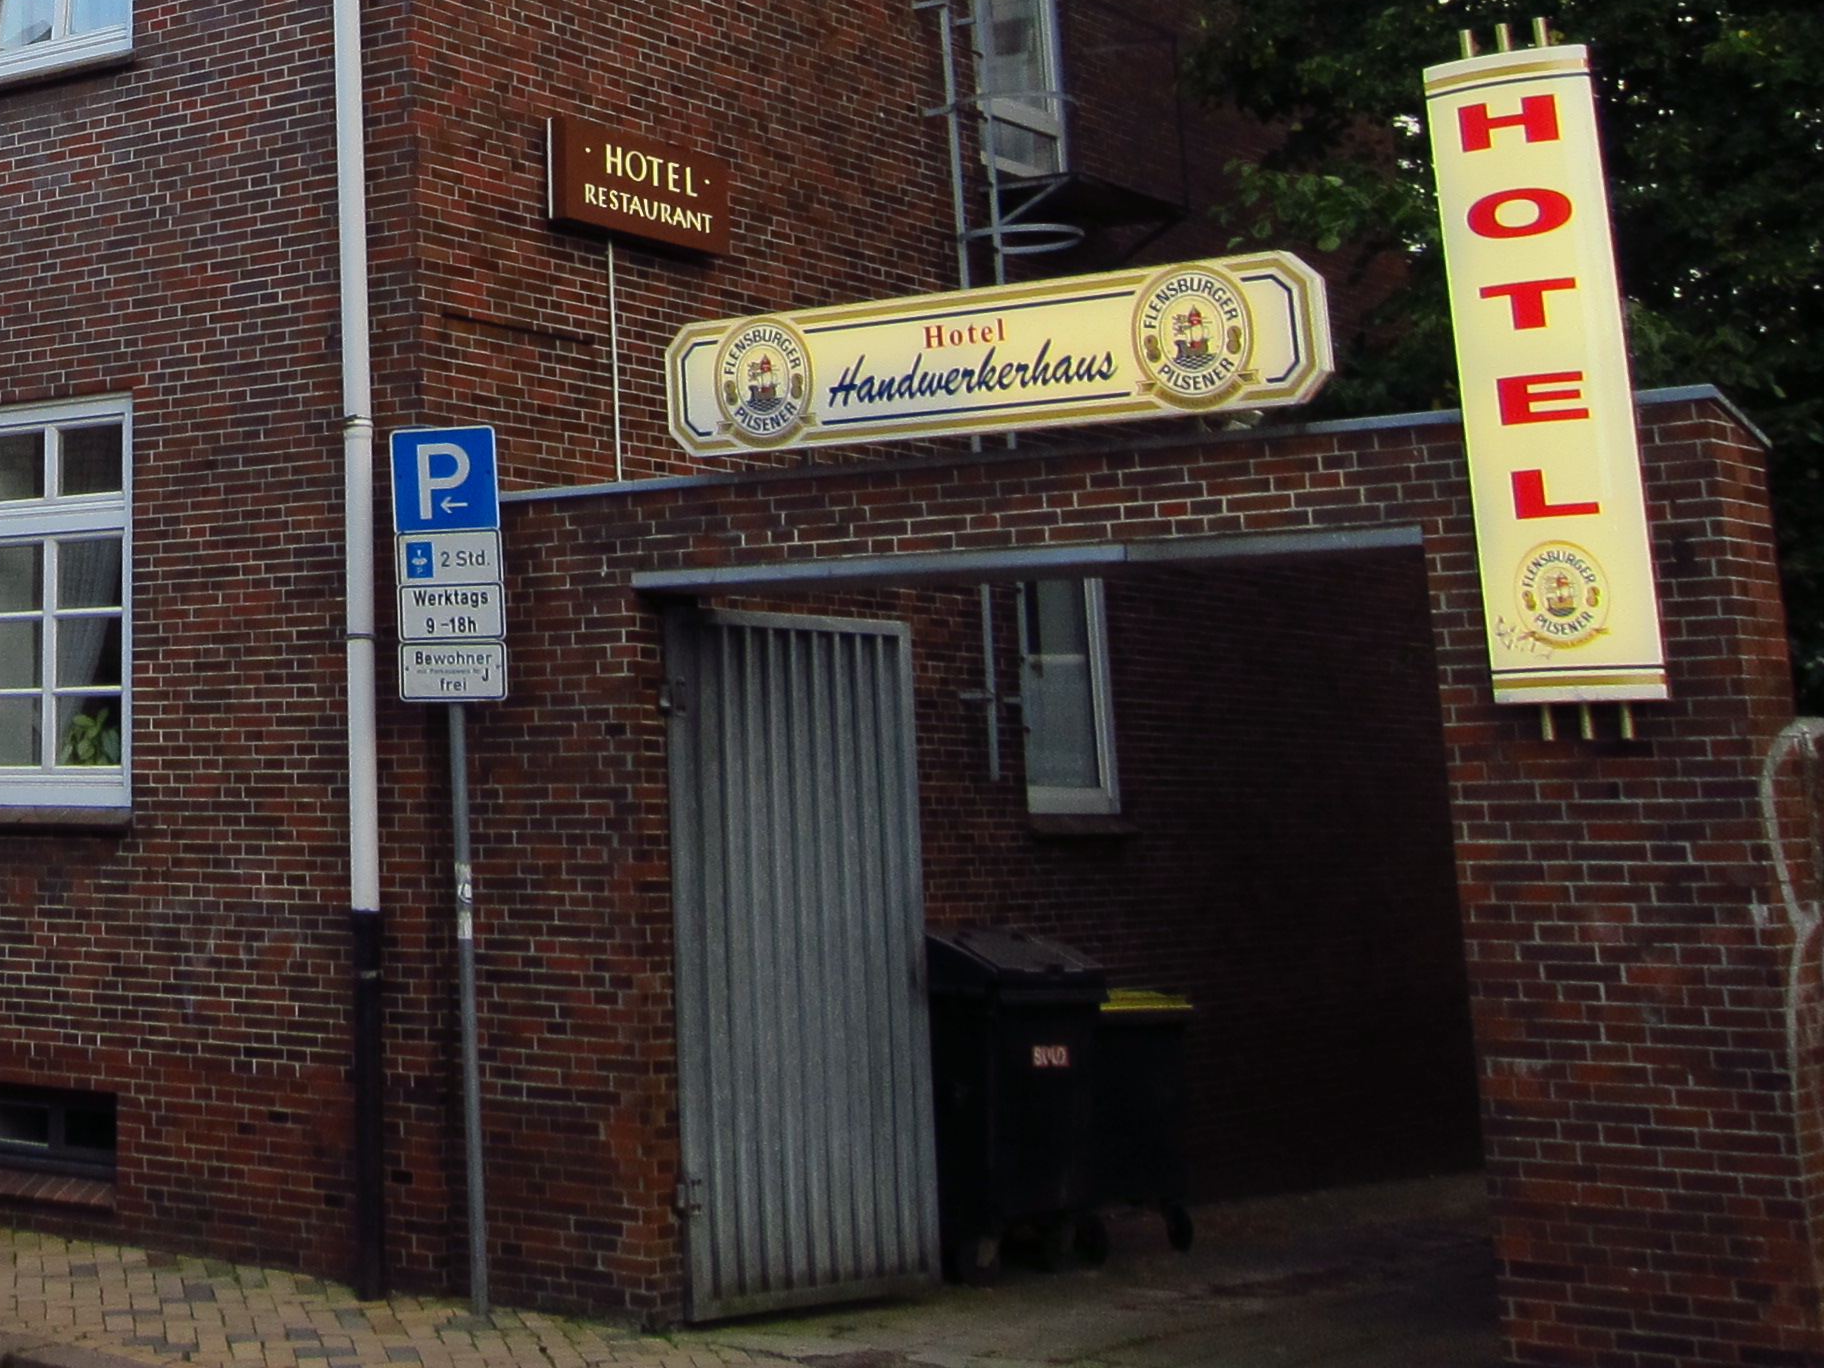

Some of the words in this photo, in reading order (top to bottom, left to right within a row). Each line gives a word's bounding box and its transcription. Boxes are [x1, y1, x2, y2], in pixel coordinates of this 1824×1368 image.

[605, 143, 699, 197] HOTEL
[584, 183, 714, 234] RESTAURANT
[1144, 277, 1239, 329] FLENSBURGER
[1457, 93, 1601, 520] HOTEL
[923, 318, 1007, 349] Hotel
[724, 328, 801, 375] FLENSBURGER
[828, 338, 1119, 407] Handwerkerhaus
[1158, 357, 1235, 391] PILSENER
[734, 401, 797, 431] PILSENER
[416, 442, 470, 520] P
[440, 551, 450, 568] 2
[456, 549, 491, 567] Std.
[1522, 550, 1596, 588] FLENSBURGER
[413, 589, 488, 608] Werktags
[426, 617, 435, 634] 9
[1535, 610, 1594, 635] PILSENER
[415, 650, 492, 666] Bewohner
[440, 677, 467, 692] frei
[482, 667, 489, 682] J
